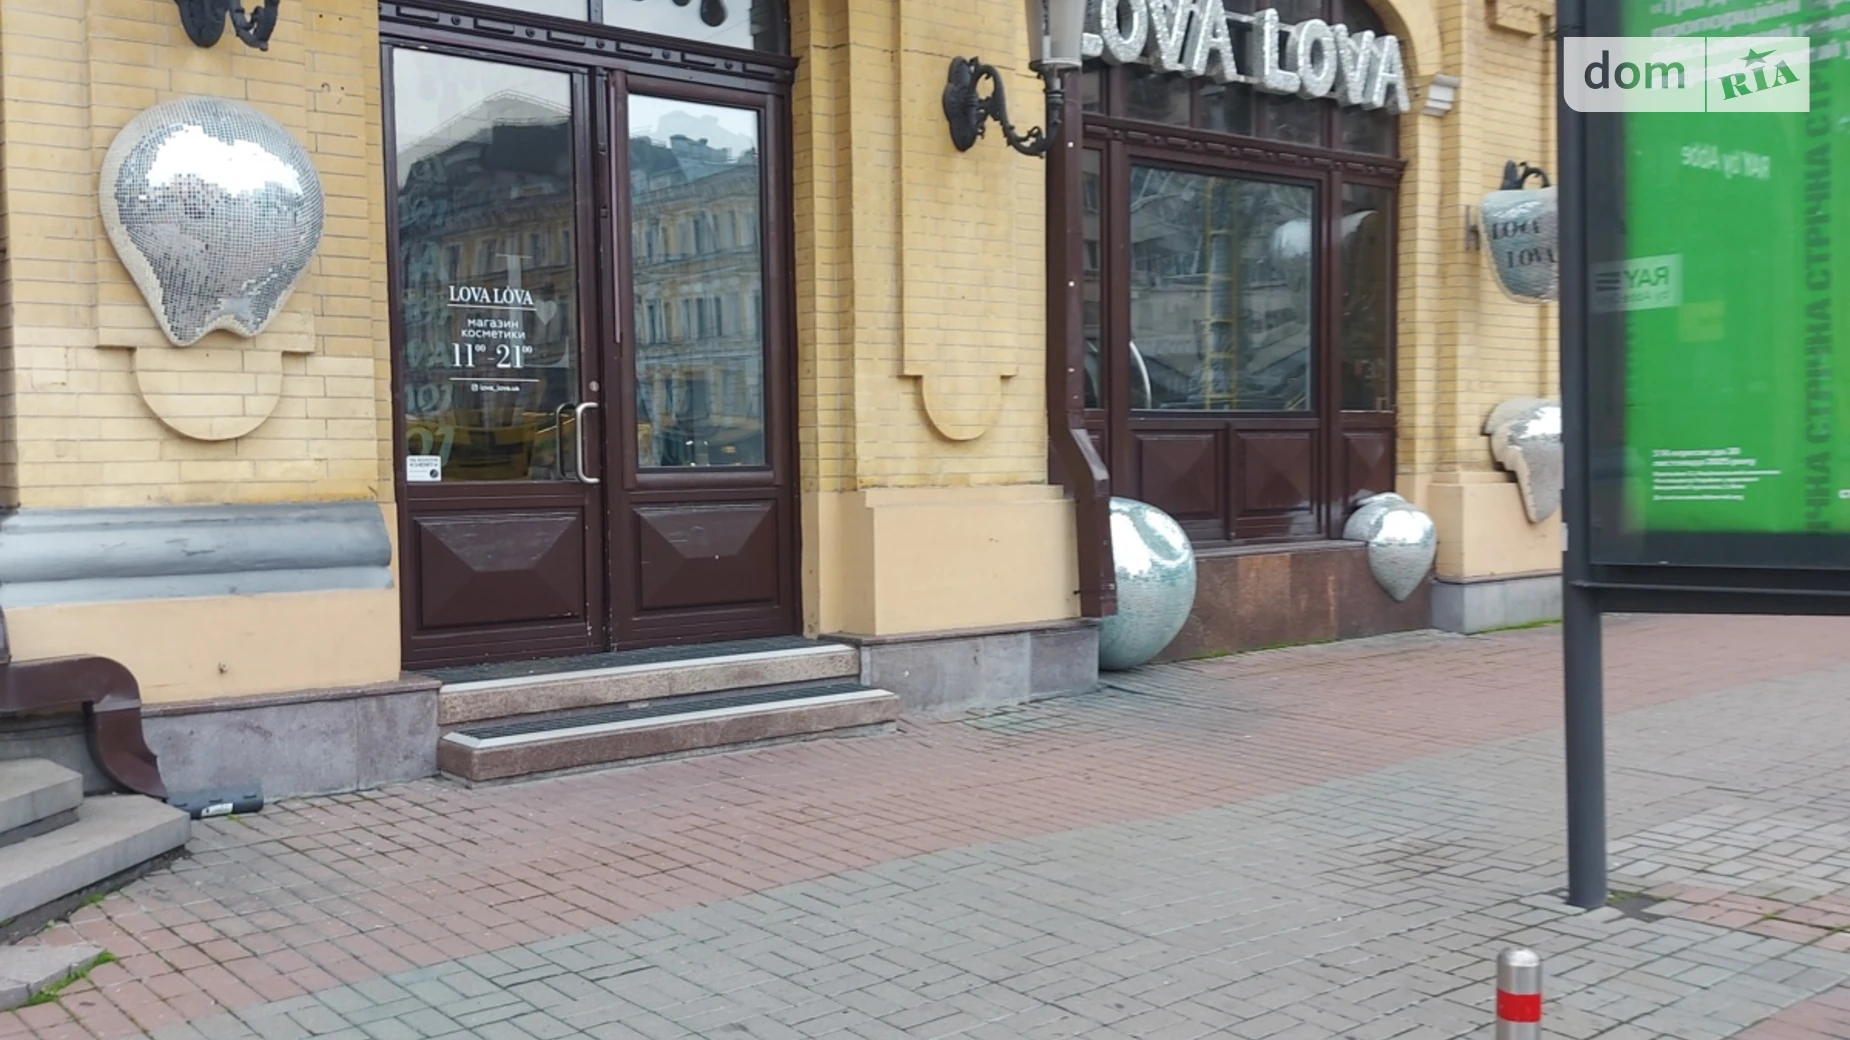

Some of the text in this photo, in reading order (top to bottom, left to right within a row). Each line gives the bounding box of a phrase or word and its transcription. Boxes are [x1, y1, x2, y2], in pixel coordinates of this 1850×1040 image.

[1082, 0, 1410, 112] OVA LOVA
[449, 285, 492, 303] LOVA
[467, 318, 519, 329] магазин
[461, 329, 526, 340] косметики
